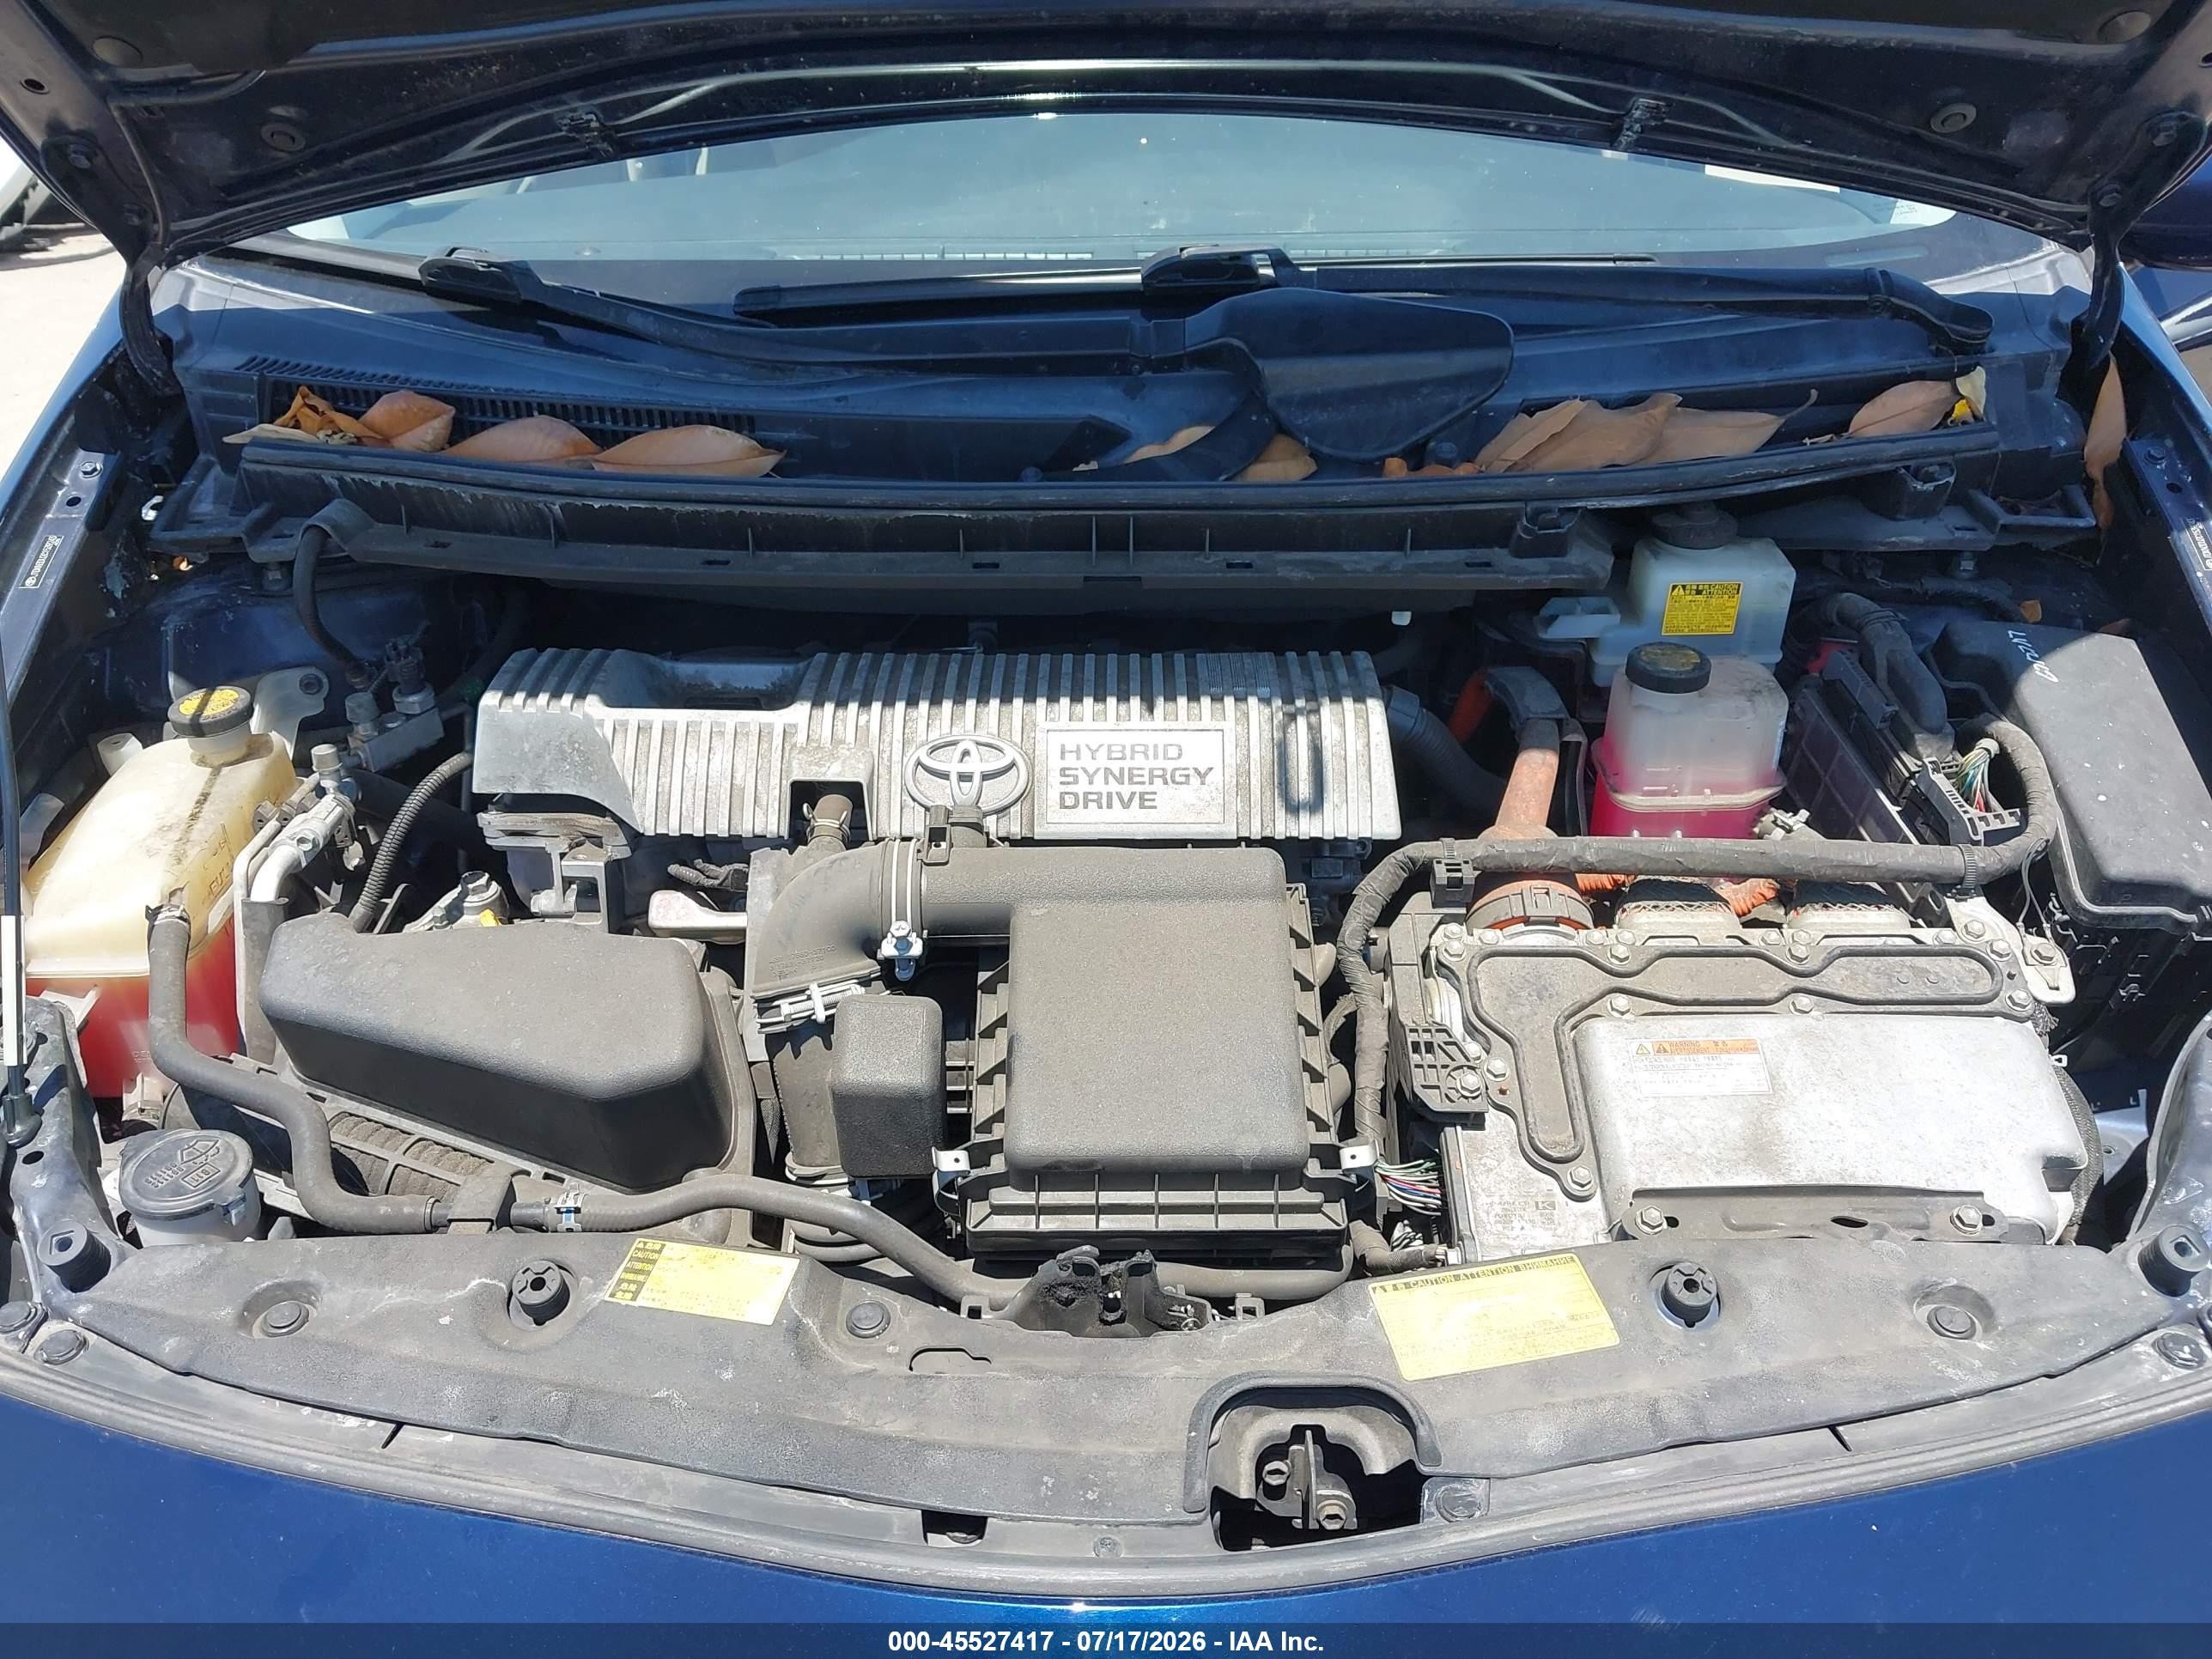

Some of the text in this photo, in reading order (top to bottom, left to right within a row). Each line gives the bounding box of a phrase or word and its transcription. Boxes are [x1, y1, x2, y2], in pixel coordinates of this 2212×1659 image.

[1059, 743, 1183, 761] HYBRID
[1059, 767, 1214, 786] SYNERGY
[1059, 791, 1158, 810] DRIVE
[632, 1249, 660, 1261] CAUTION
[626, 1261, 653, 1272] ATTENTION
[1410, 1276, 1455, 1288] CAUTION
[1460, 1265, 1515, 1281] ATTENTION
